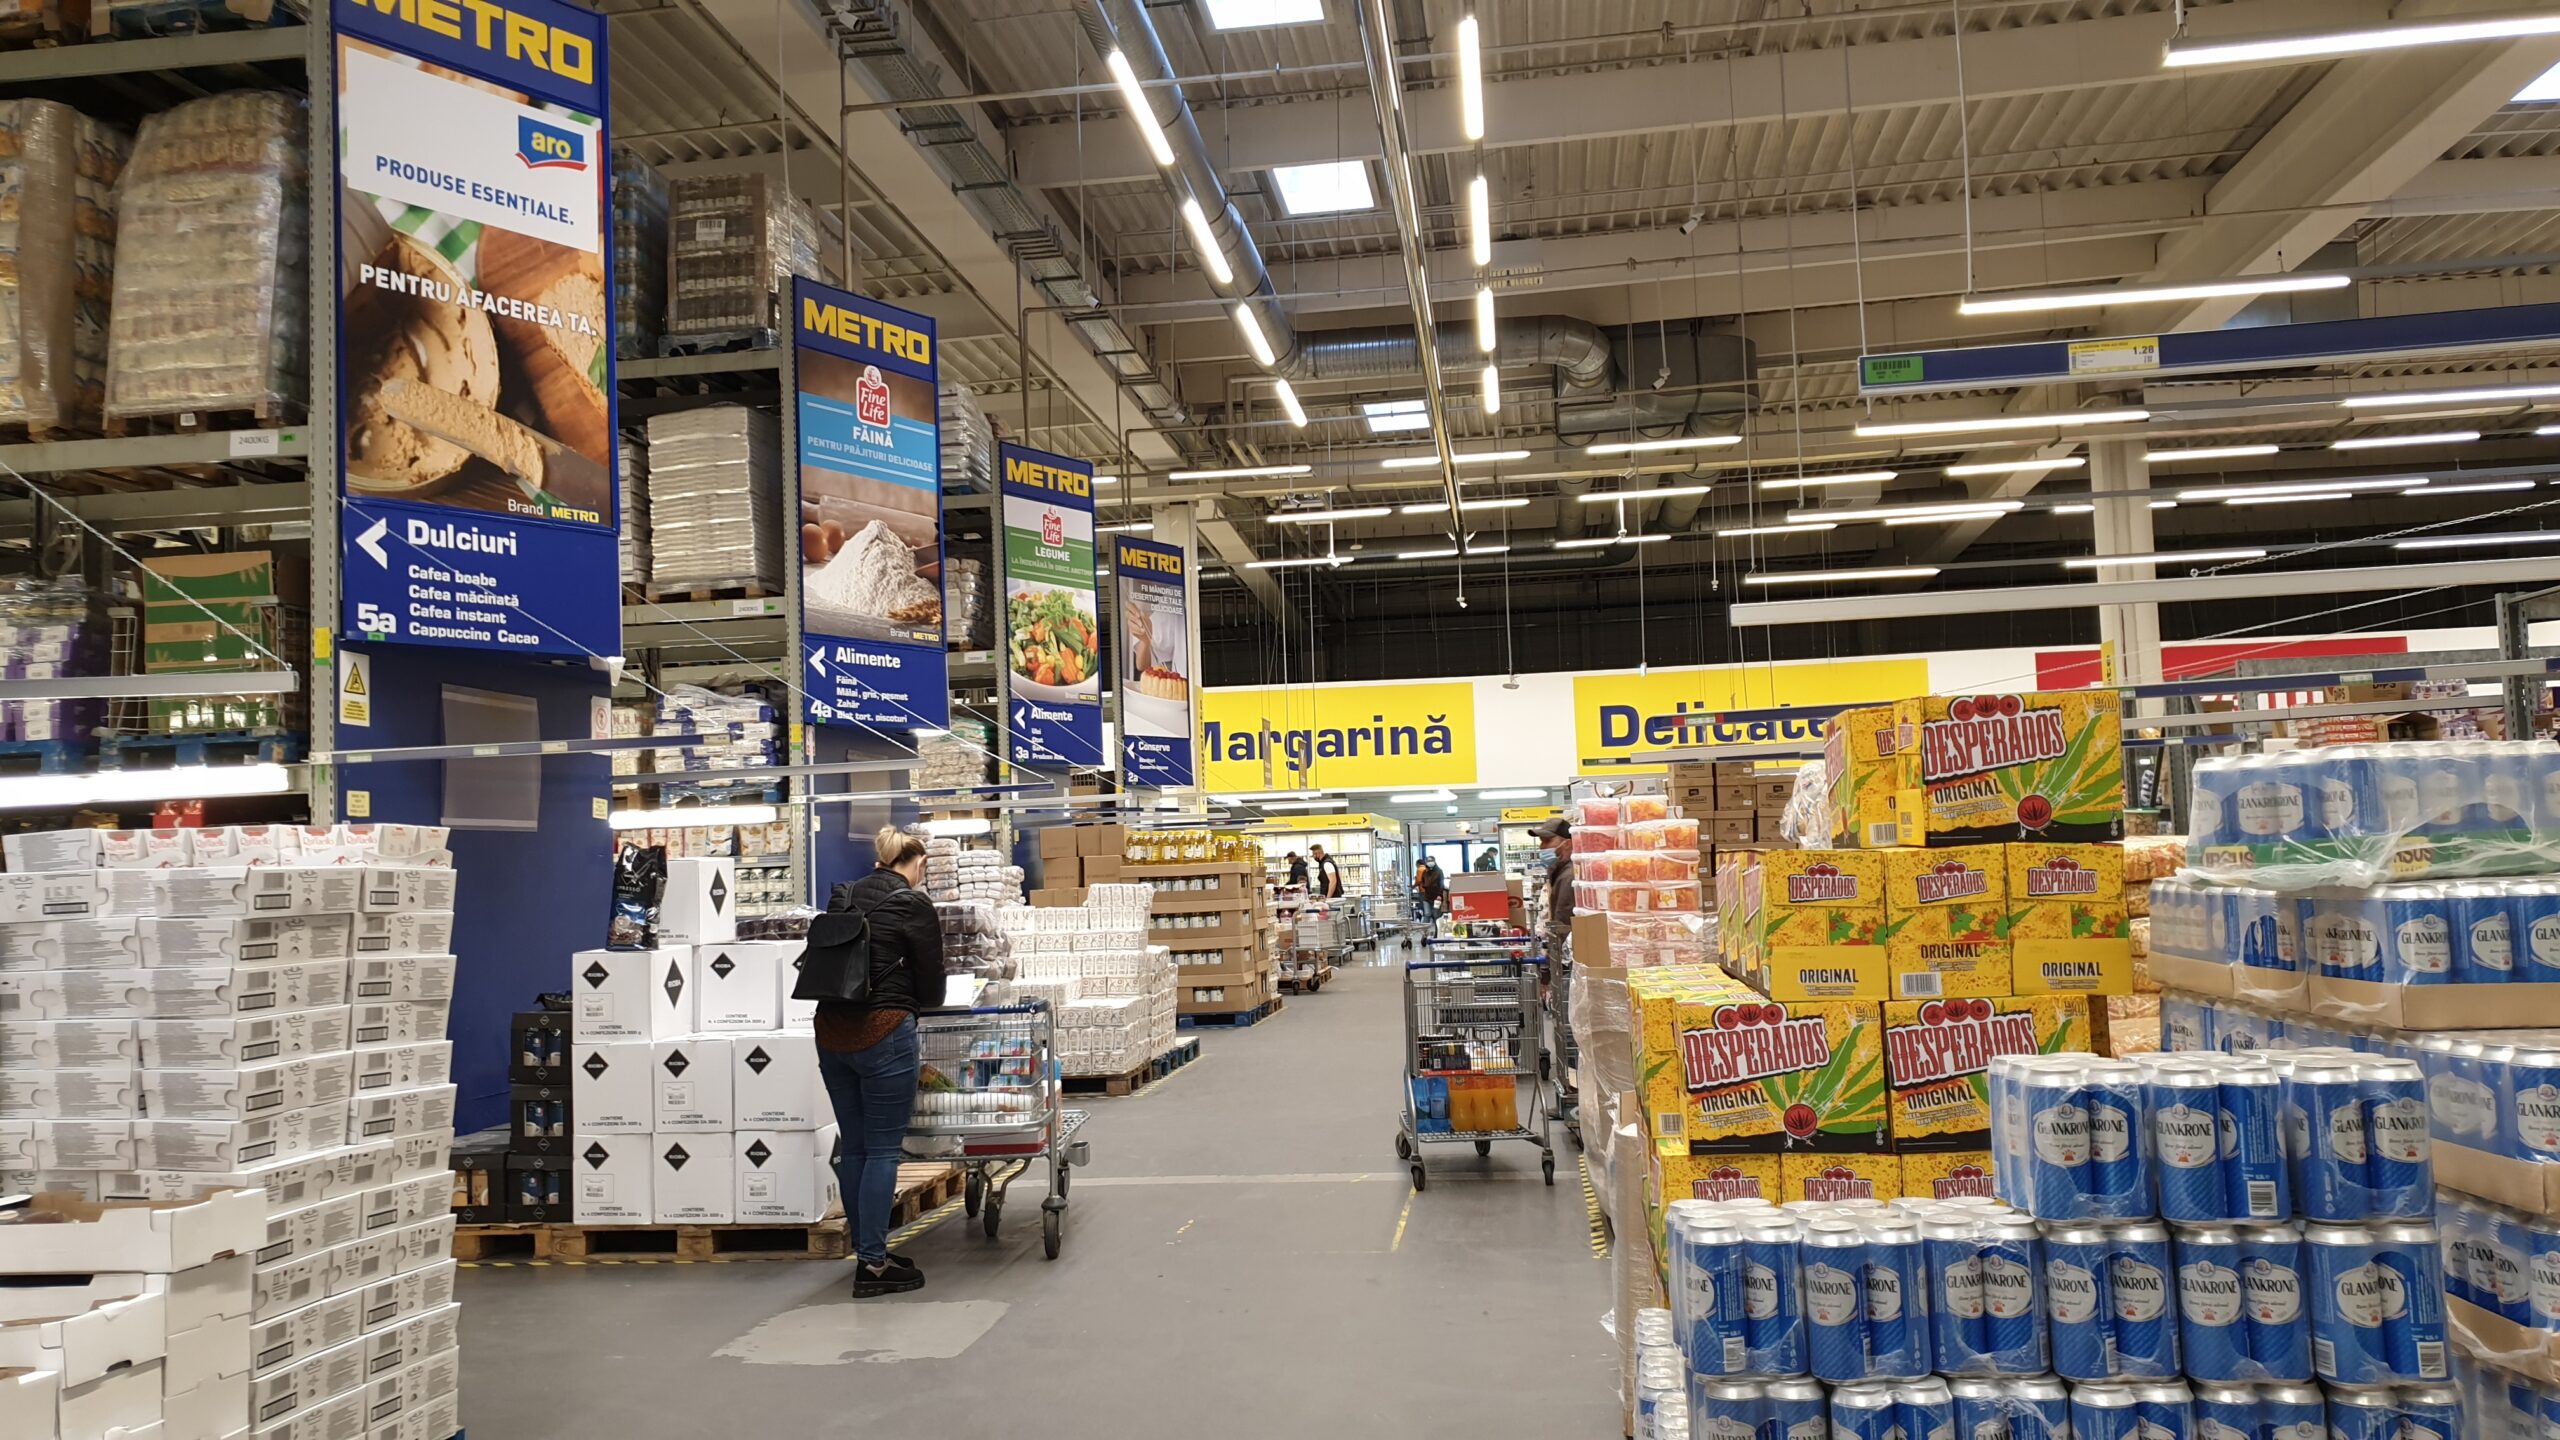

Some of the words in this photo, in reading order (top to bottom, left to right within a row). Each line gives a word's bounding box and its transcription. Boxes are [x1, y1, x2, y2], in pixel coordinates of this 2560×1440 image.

[355, 0, 592, 84] ETRO
[531, 131, 571, 159] aro
[376, 155, 465, 195] PRODUSE
[472, 182, 574, 225] ESENȚIALE.
[360, 263, 449, 302] PENTRU
[456, 287, 563, 328] AFACEREA
[568, 312, 597, 336] TA.
[804, 297, 930, 365] METRO
[860, 387, 886, 407] Fine
[862, 403, 885, 421] Life
[853, 425, 894, 448] FĂINĂ
[807, 436, 843, 451] PENTRU
[888, 454, 933, 472] DELICIOASE
[1006, 457, 1090, 497] METRO
[508, 499, 543, 516] Brand
[551, 506, 600, 523] METRO
[408, 519, 517, 556] Dulciuri
[1035, 546, 1070, 562] LEGUME
[1121, 546, 1182, 574] METRO
[408, 565, 451, 582] Cafea
[455, 570, 497, 587] boabe
[409, 585, 451, 602] Cafea
[456, 589, 519, 607] măcinată
[357, 602, 396, 634] 5a
[409, 602, 451, 619] Cafea
[456, 607, 507, 624] instant
[409, 622, 491, 642] Cappuccino
[498, 629, 539, 645] Cacao
[912, 631, 940, 642] METRO
[836, 646, 901, 668] Alimente
[810, 700, 832, 718] 4a
[1031, 707, 1073, 722] Alimente
[1015, 747, 1029, 759] 3a
[1138, 741, 1170, 752] Conserve
[1923, 712, 2065, 778] DESPERADOS
[1128, 772, 1138, 782] 2a
[1934, 778, 2003, 804] ORIGINAL
[1790, 875, 1856, 900] DESPERADOS
[1918, 872, 1986, 901] DESPERADOS
[2029, 869, 2096, 894] DESPERADOS
[1920, 942, 1981, 959] ORIGINAL
[1799, 969, 1858, 983] ORIGINAL
[2042, 962, 2103, 977] ORIGINAL
[1684, 1021, 1829, 1085] DESPERADOS
[1889, 1016, 2038, 1082] DESPERADOS
[1701, 1087, 1768, 1113] ORIGINAL
[1907, 1084, 1976, 1110] ORIGINAL
[1694, 1180, 1760, 1201] DESPERADOS
[1805, 1179, 1871, 1201] DESPERADOS
[1984, 1273, 2027, 1289] ANKRONE
[2051, 1277, 2091, 1294] NKRONE
[2113, 1276, 2159, 1292] ANKRONE
[2182, 1277, 2237, 1294] LANKRONE
